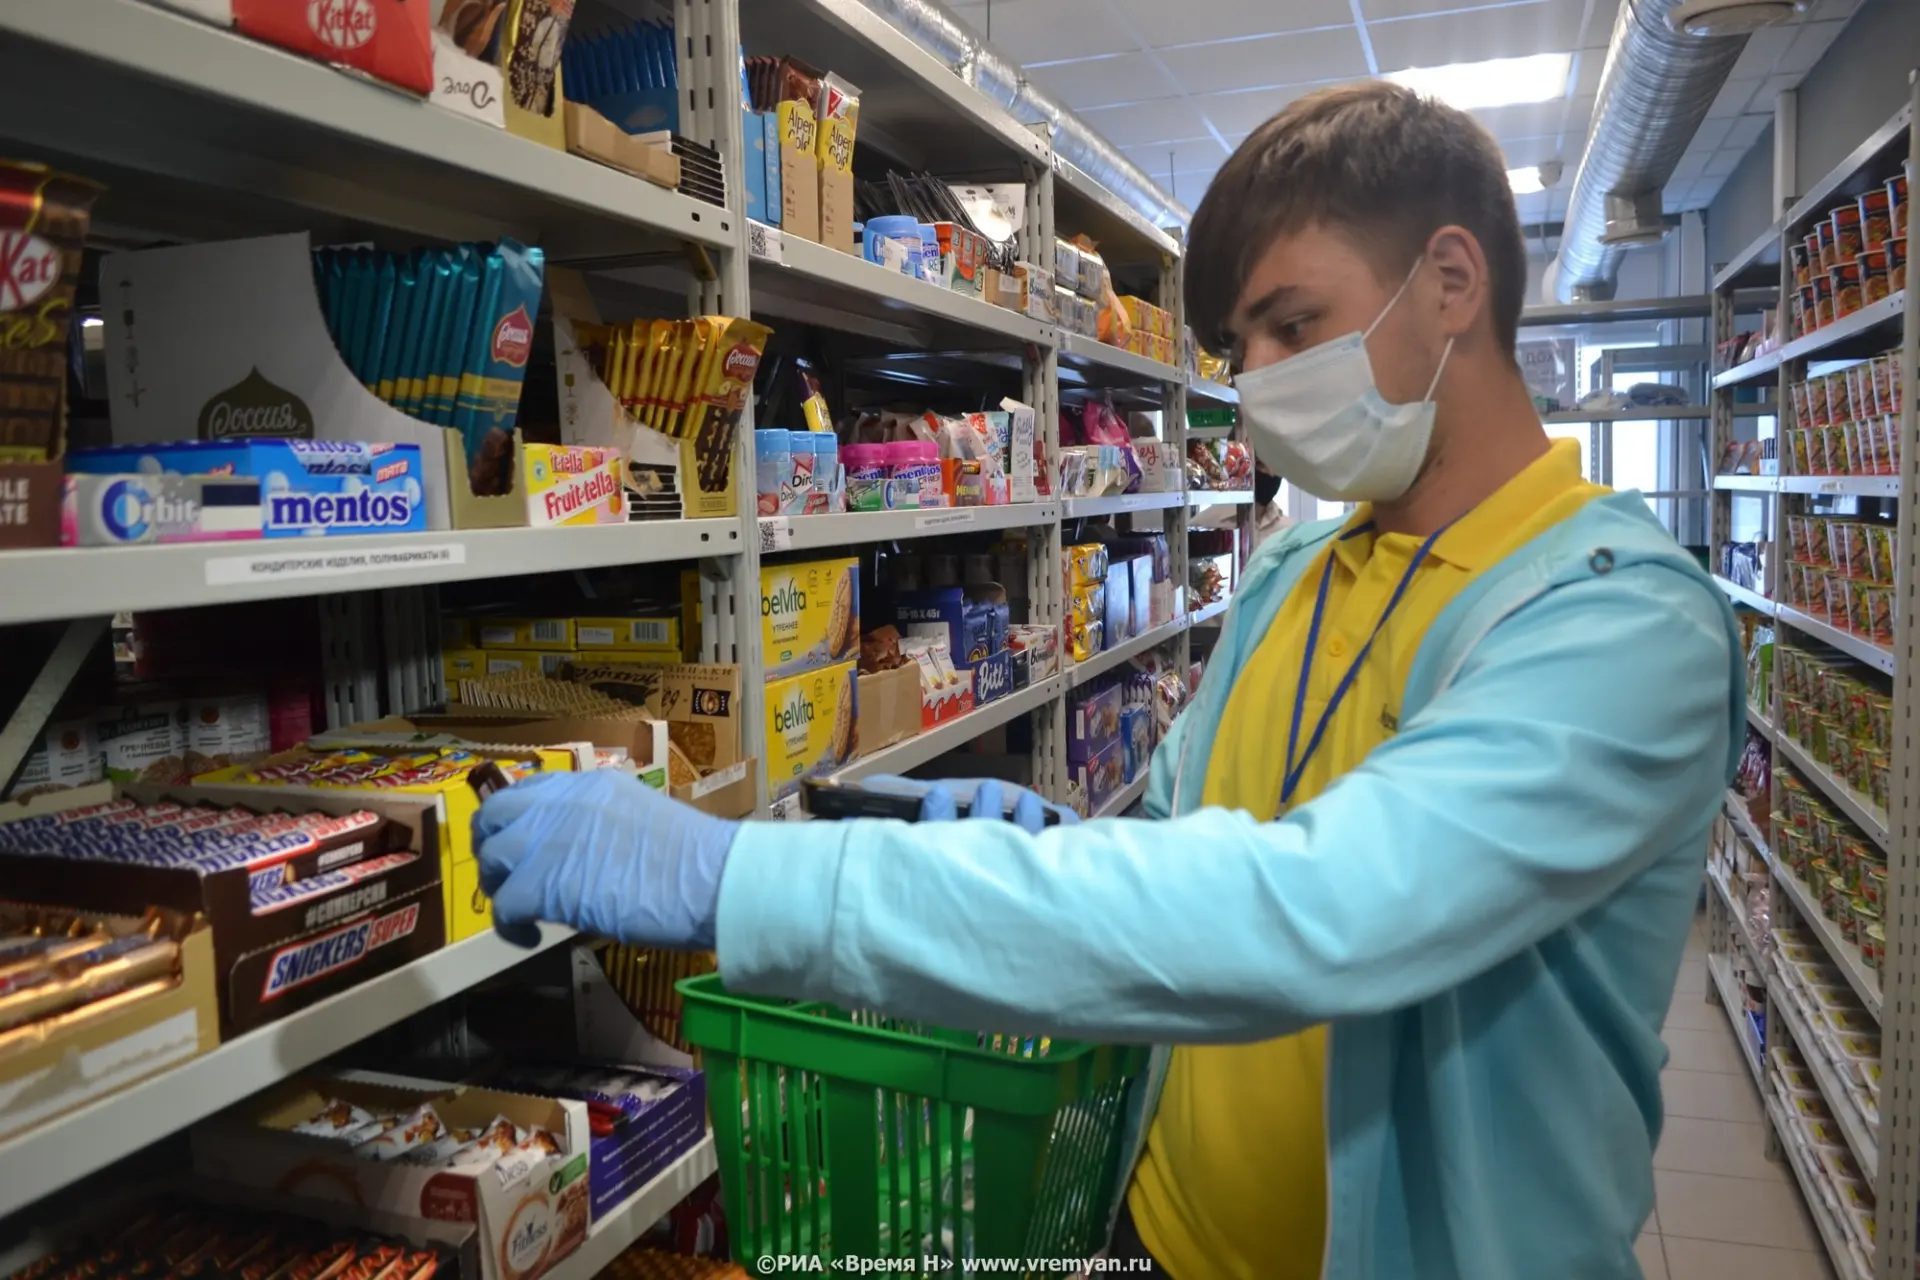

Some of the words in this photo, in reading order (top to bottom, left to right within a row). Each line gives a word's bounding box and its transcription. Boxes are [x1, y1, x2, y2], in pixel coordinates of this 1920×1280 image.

[314, 0, 374, 45] KitKat
[788, 107, 815, 135] Alpen
[830, 125, 852, 151] Alpen
[208, 401, 305, 438] Россия
[101, 478, 200, 543] Orbit
[270, 491, 409, 527] mentos
[544, 471, 614, 520] Fruit-tella
[761, 577, 806, 617] belVita
[774, 690, 815, 734] belVita
[269, 922, 370, 990] SNICKERS
[371, 906, 416, 946] SUPER
